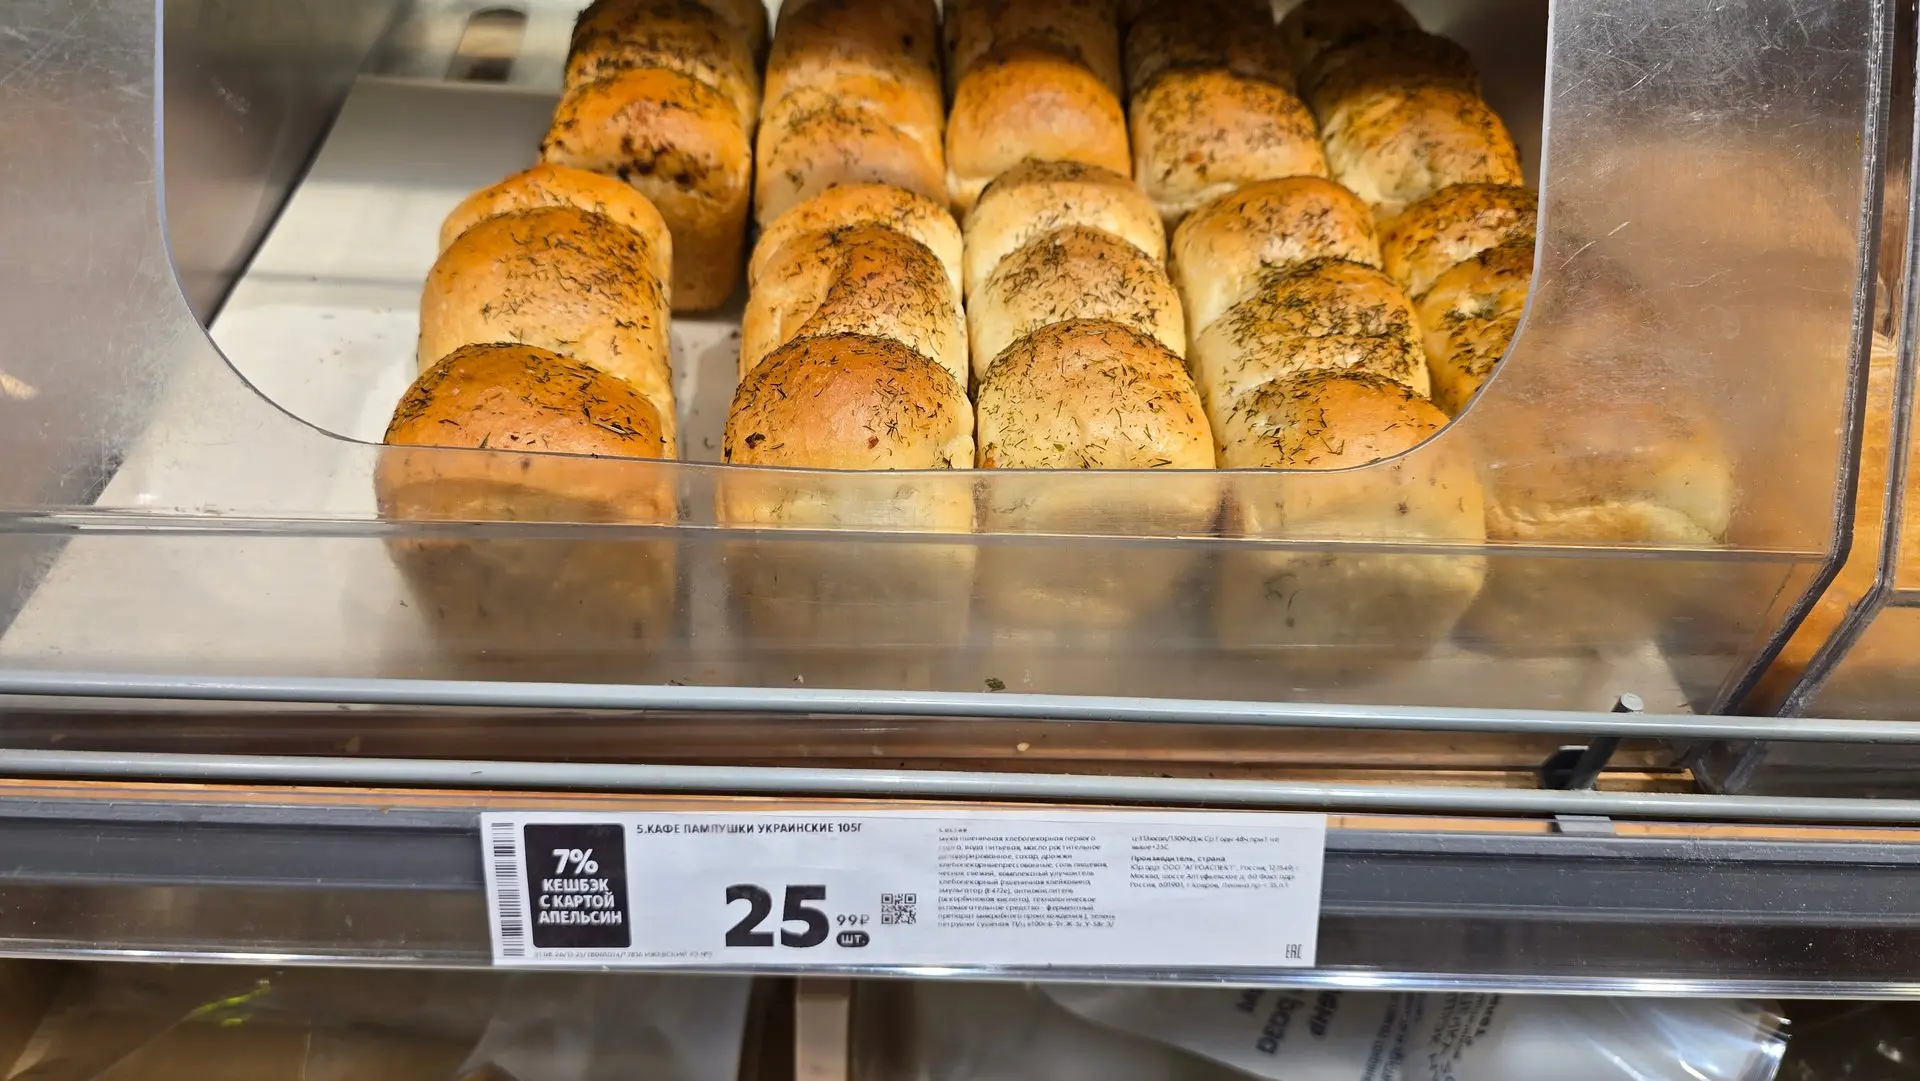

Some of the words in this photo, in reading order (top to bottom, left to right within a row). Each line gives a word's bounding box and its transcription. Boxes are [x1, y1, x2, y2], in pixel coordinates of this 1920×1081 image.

[637, 823, 681, 834] 5.КАФЕ
[684, 823, 754, 834] ПАМПУШКИ
[758, 822, 834, 833] УКРАИНСКИЕ
[553, 848, 599, 875] 7%
[542, 878, 609, 892] КЕШБЭК
[539, 895, 550, 908] С
[553, 891, 615, 908] КАРТОЙ
[538, 910, 623, 925] АПЕЛЬСИН
[725, 883, 830, 948] 25
